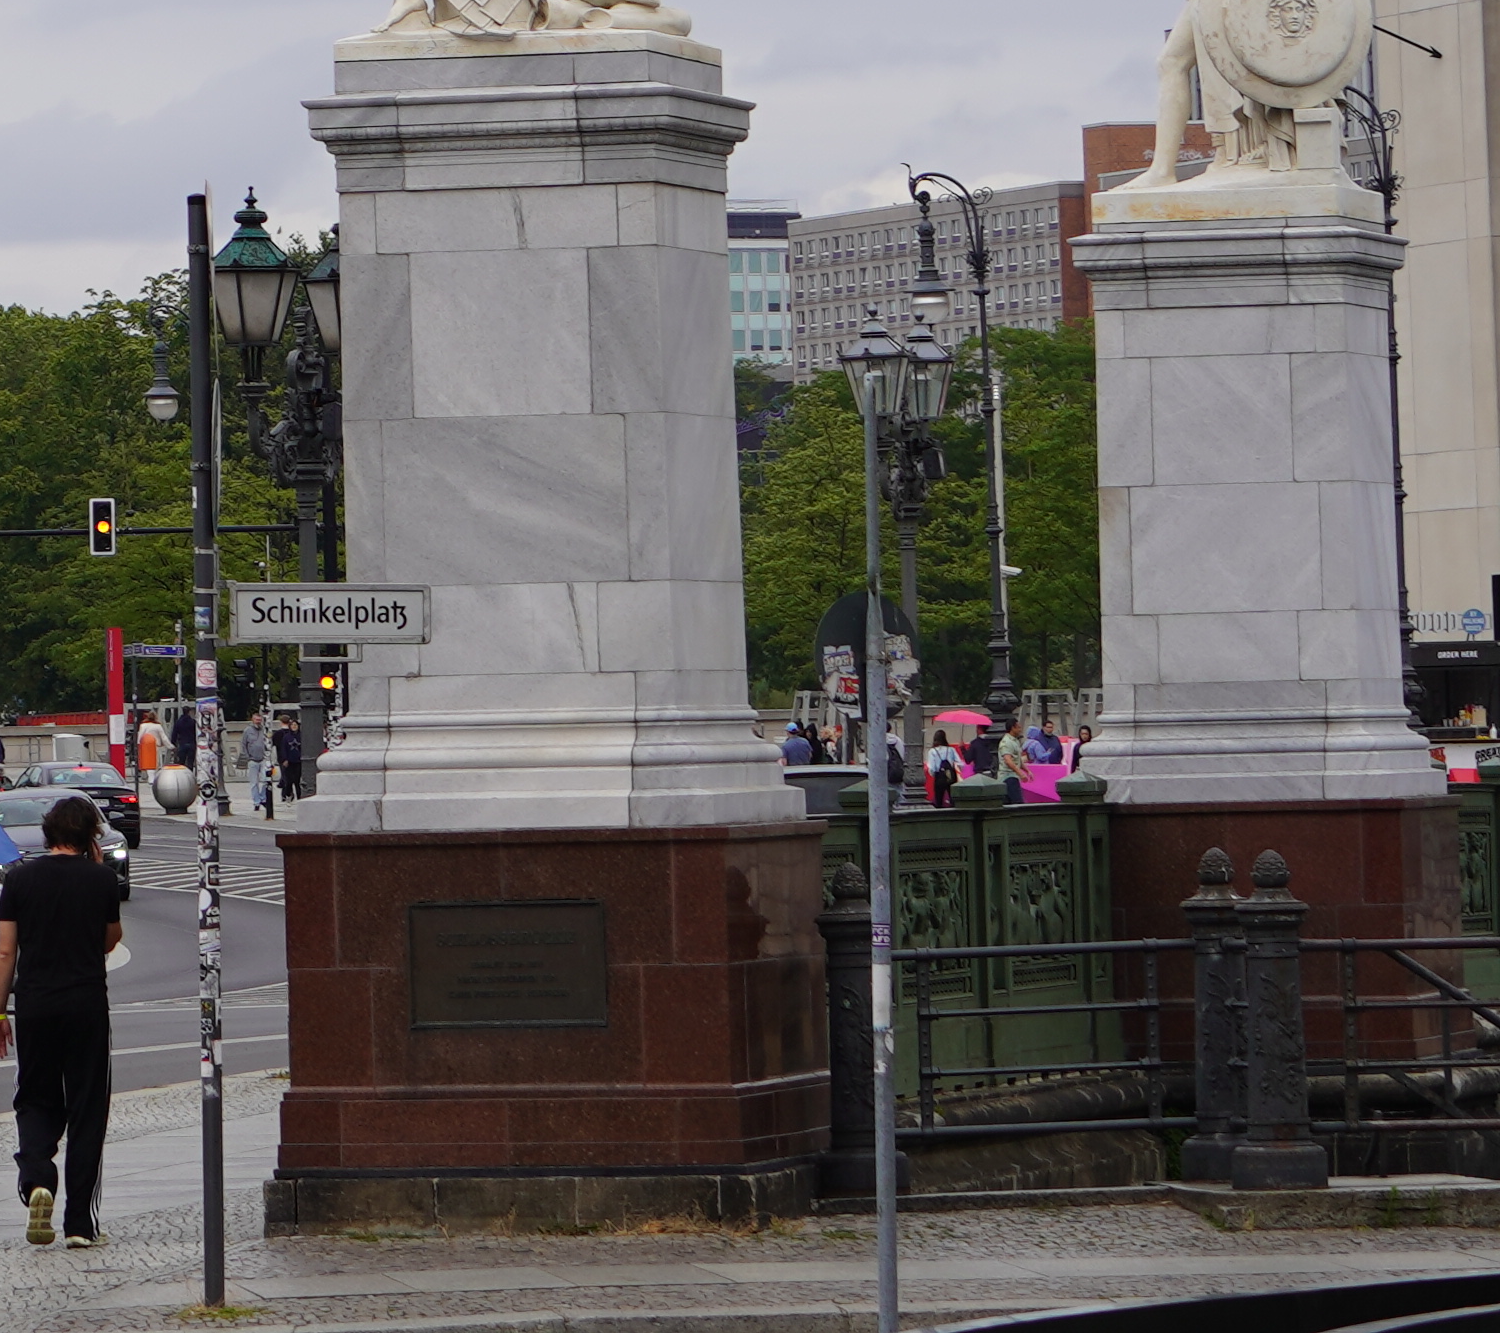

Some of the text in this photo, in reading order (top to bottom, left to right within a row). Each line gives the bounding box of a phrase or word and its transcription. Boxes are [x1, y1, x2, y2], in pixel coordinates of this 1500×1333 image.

[251, 597, 408, 630] Schinkelplatz
[1437, 650, 1479, 659] ORDER HERE
